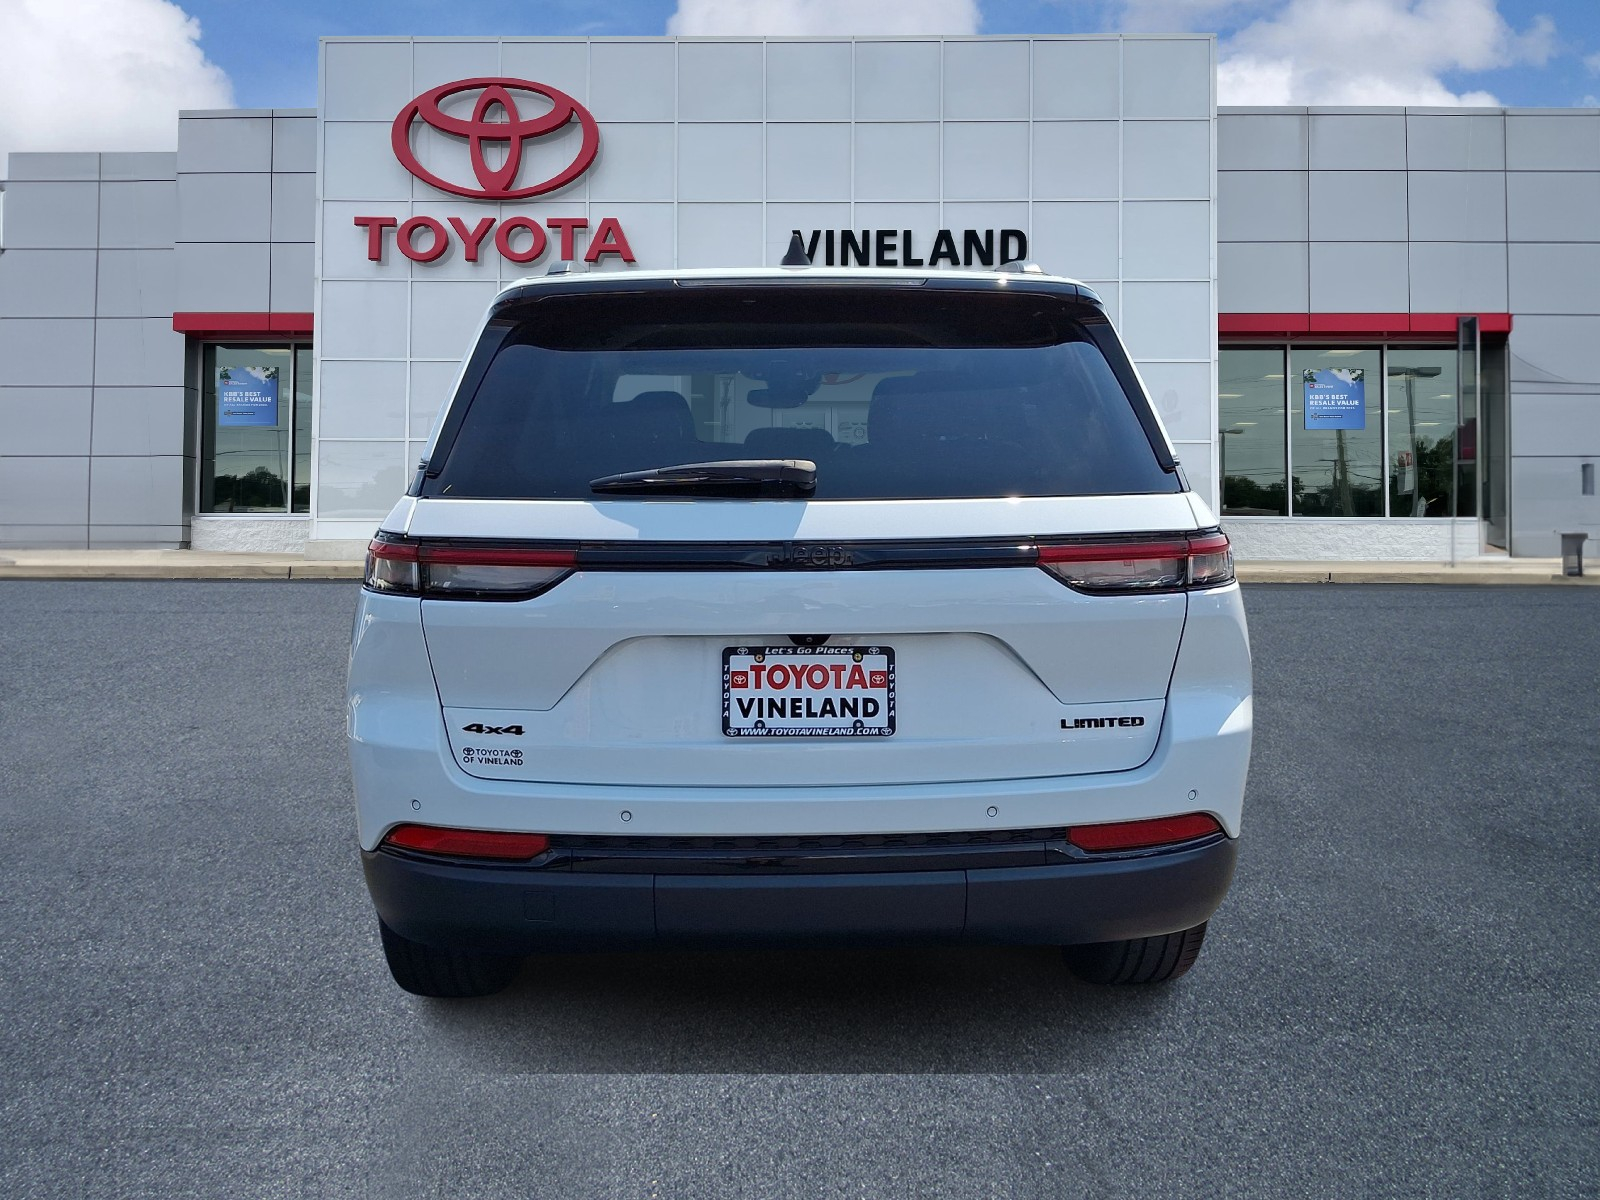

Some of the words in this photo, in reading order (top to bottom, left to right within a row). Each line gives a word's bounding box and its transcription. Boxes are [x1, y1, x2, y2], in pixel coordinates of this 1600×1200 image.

[354, 216, 636, 262] TOYOTA
[792, 229, 1027, 266] VINELAND
[765, 646, 793, 655] Let's
[796, 646, 812, 655] Go
[817, 646, 854, 655] Places
[750, 663, 868, 690] TOYOTA
[888, 664, 896, 717] TOYOTA
[736, 697, 880, 719] VINELAND
[1060, 716, 1145, 729] LIMITED
[462, 723, 526, 736] 4x4
[740, 727, 879, 736] WWW.TOYOTAVINELAND.COM
[475, 748, 511, 757] TOYOTA
[478, 757, 523, 766] VINELAND
